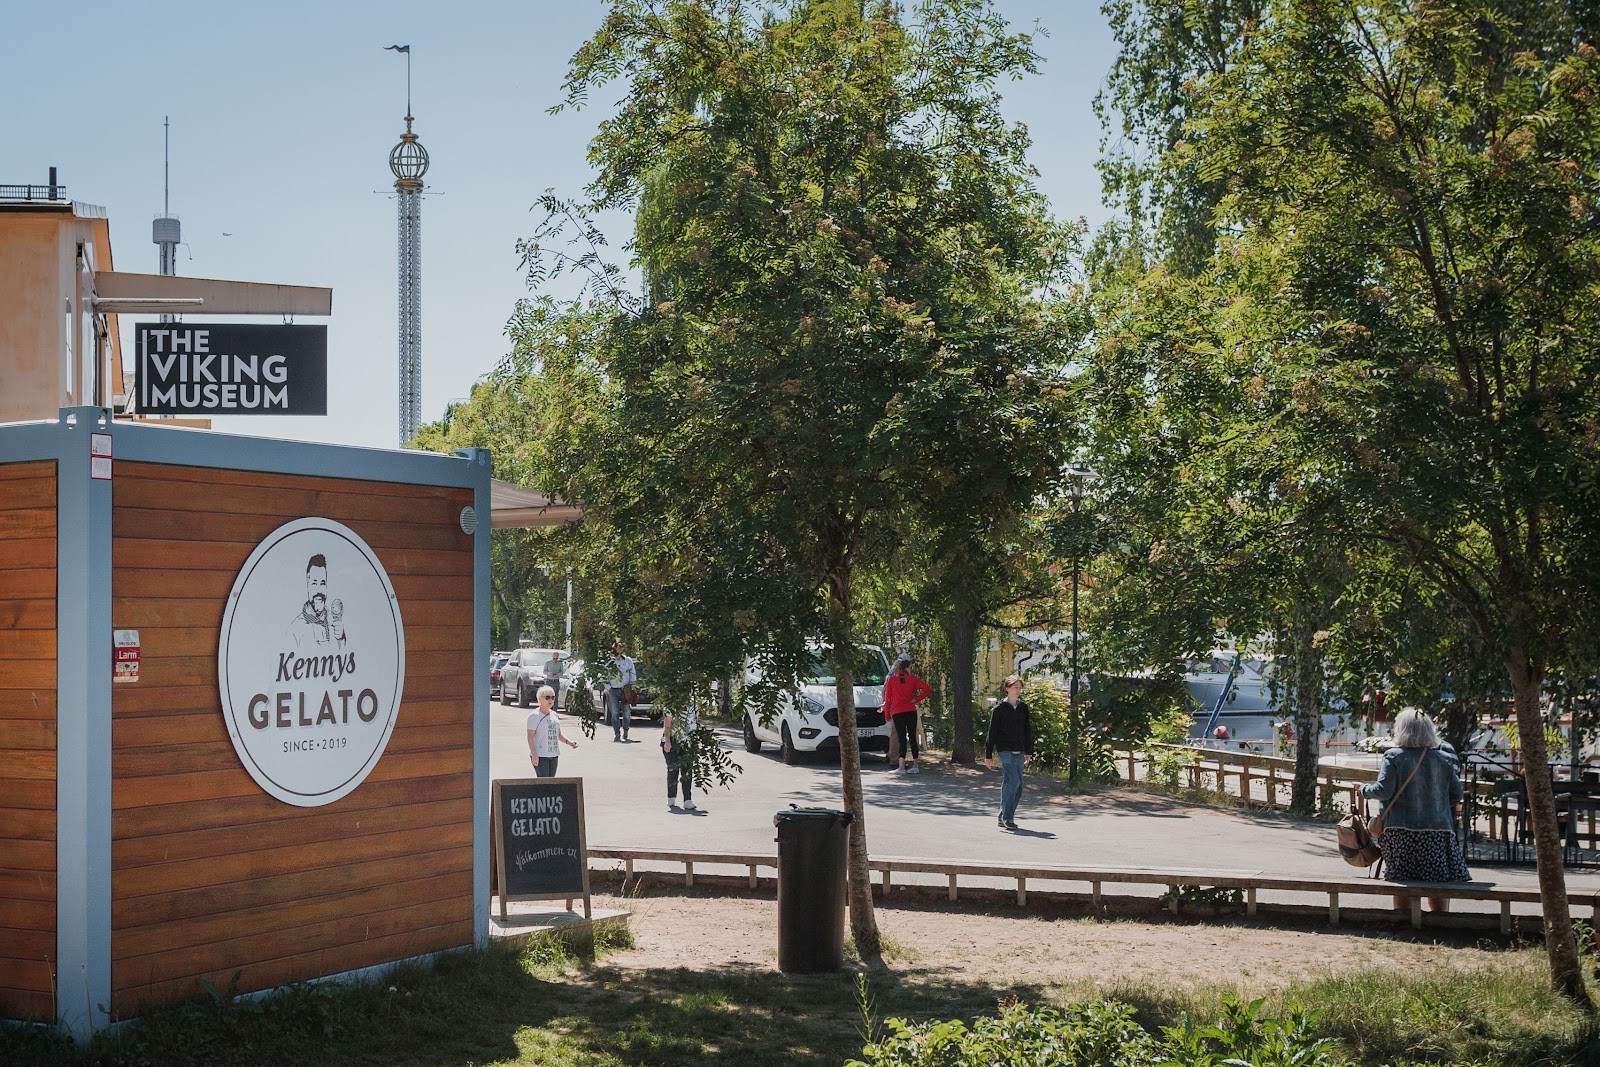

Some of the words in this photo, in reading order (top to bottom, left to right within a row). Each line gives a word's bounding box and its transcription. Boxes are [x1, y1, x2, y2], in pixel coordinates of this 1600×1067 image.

[150, 329, 210, 353] THE
[150, 354, 288, 384] VIKING
[151, 384, 289, 409] MUSEUM
[118, 650, 137, 660] Larm
[275, 651, 356, 683] Kennys
[247, 688, 378, 730] GELATO
[510, 796, 563, 814] KENNYS
[511, 817, 560, 836] GELATO
